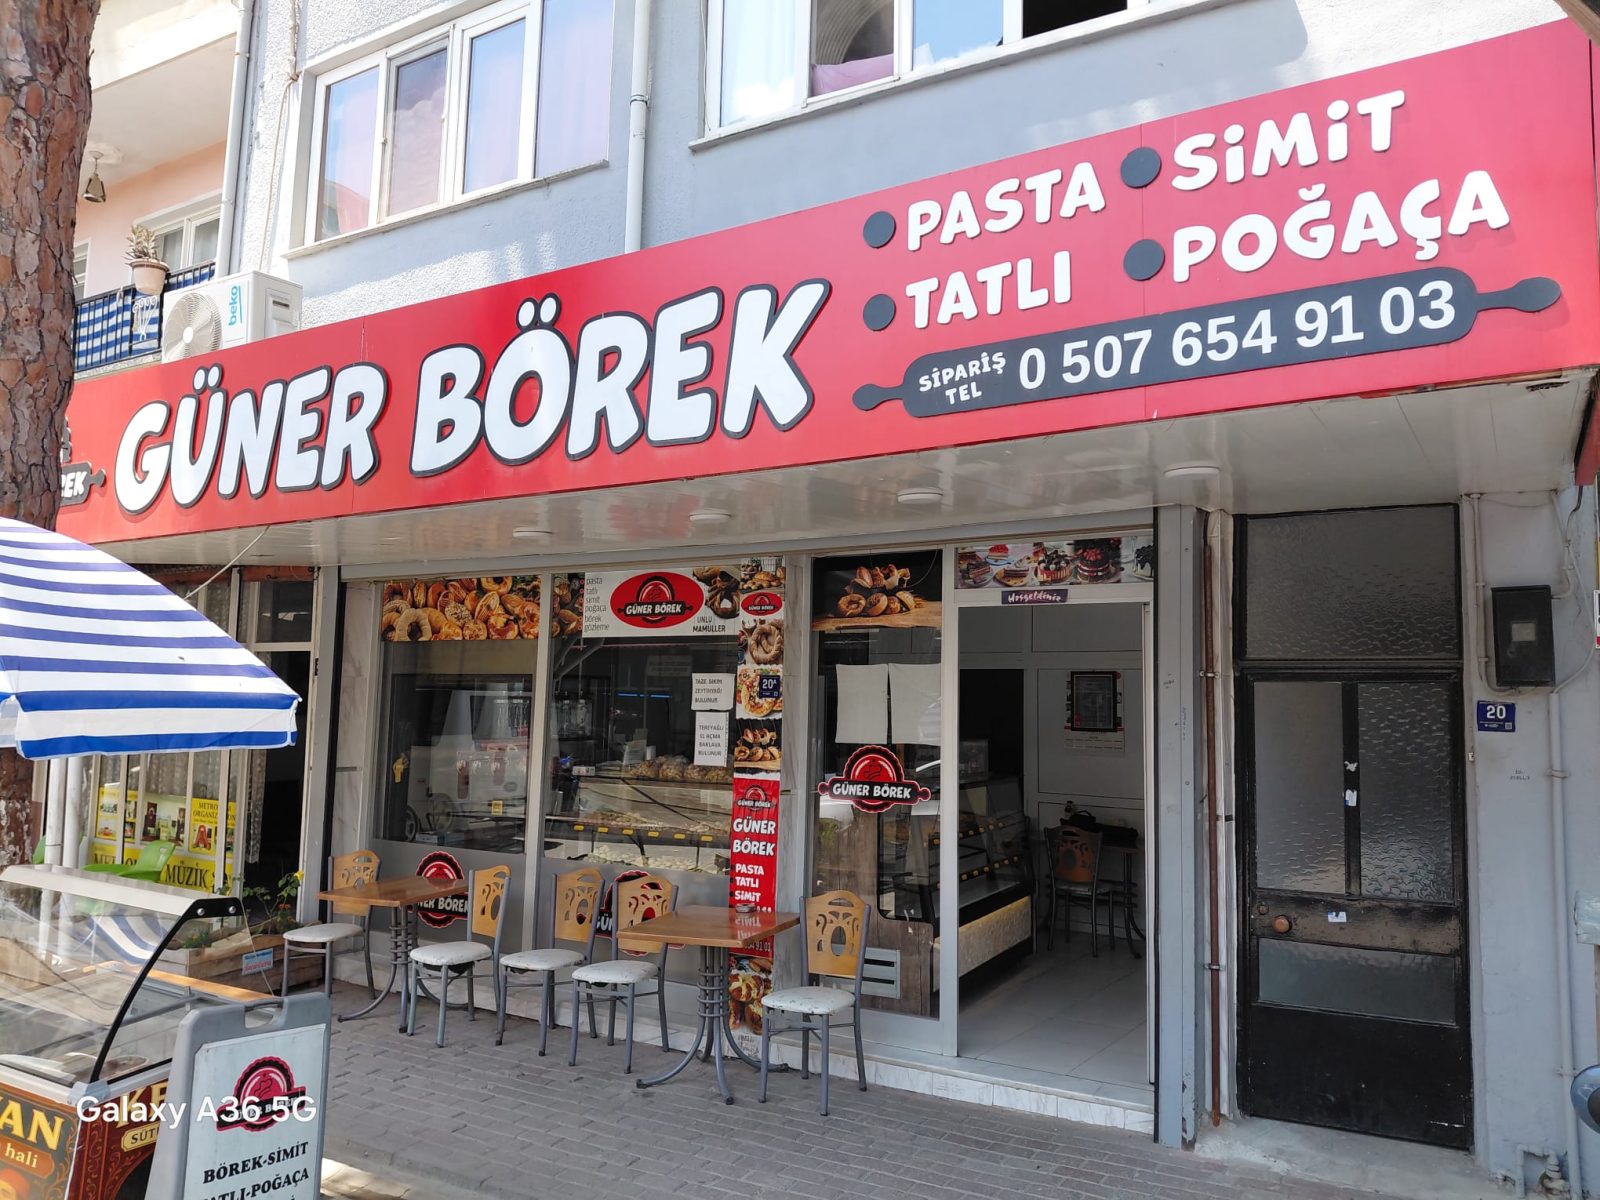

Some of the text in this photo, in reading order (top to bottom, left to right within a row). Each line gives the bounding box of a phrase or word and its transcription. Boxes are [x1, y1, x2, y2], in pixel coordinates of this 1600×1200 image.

[907, 161, 1107, 252] PASTA
[1172, 170, 1511, 284] POĞAÇA
[905, 250, 1073, 330] TATLI
[228, 285, 241, 326] beko
[1018, 280, 1457, 390] 0 507 654 91 03
[918, 351, 1007, 392] SİPARİŞ
[114, 278, 832, 515] GÜNER BÖREK
[945, 381, 983, 406] TEL
[625, 602, 682, 615] GÜNER BÖREK
[1486, 705, 1506, 719] 20
[832, 781, 912, 799] GÜNER BÖREK
[732, 815, 776, 835] GÜNER
[732, 838, 775, 856] BÖREK
[165, 861, 209, 889] MÜZİK
[735, 863, 765, 875] PASTA
[735, 876, 759, 888] TATLI
[5, 1142, 39, 1168] hali
[202, 1140, 309, 1184] BÖREK-SİMİT
